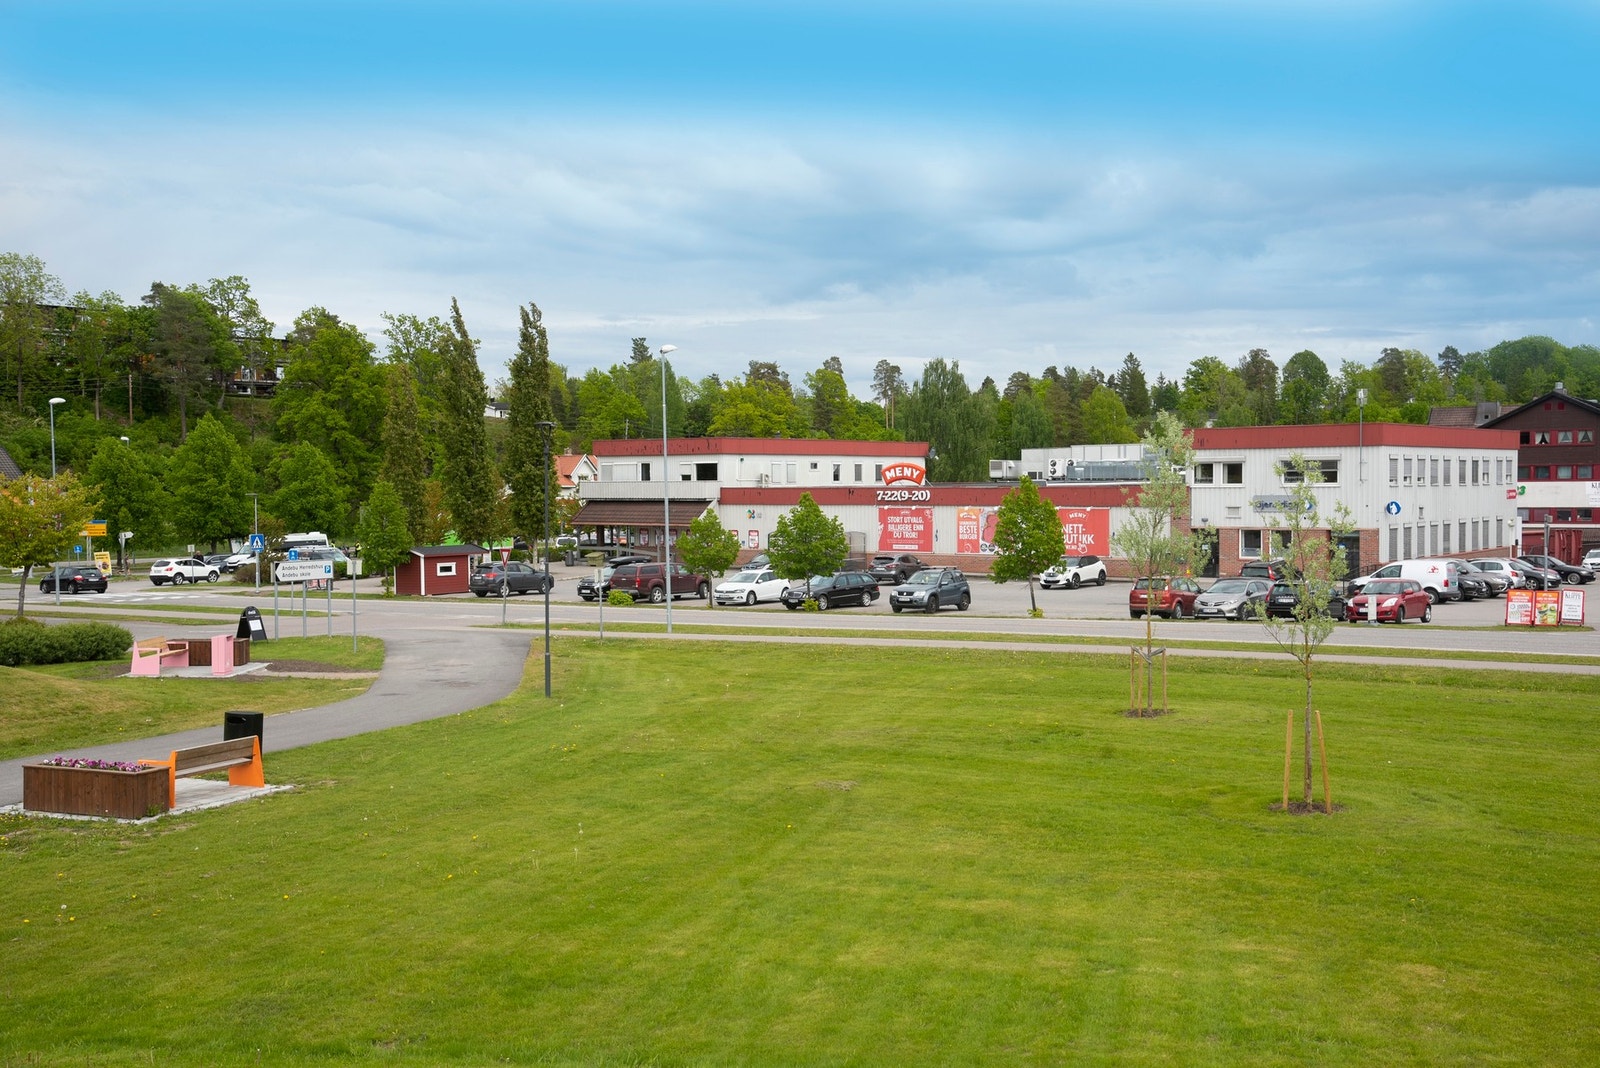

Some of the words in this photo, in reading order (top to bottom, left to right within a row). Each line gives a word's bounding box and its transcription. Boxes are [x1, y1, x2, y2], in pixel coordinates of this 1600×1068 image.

[885, 466, 920, 480] MENY
[877, 490, 930, 501] 7-22(9-20)
[959, 525, 978, 534] BESTE
